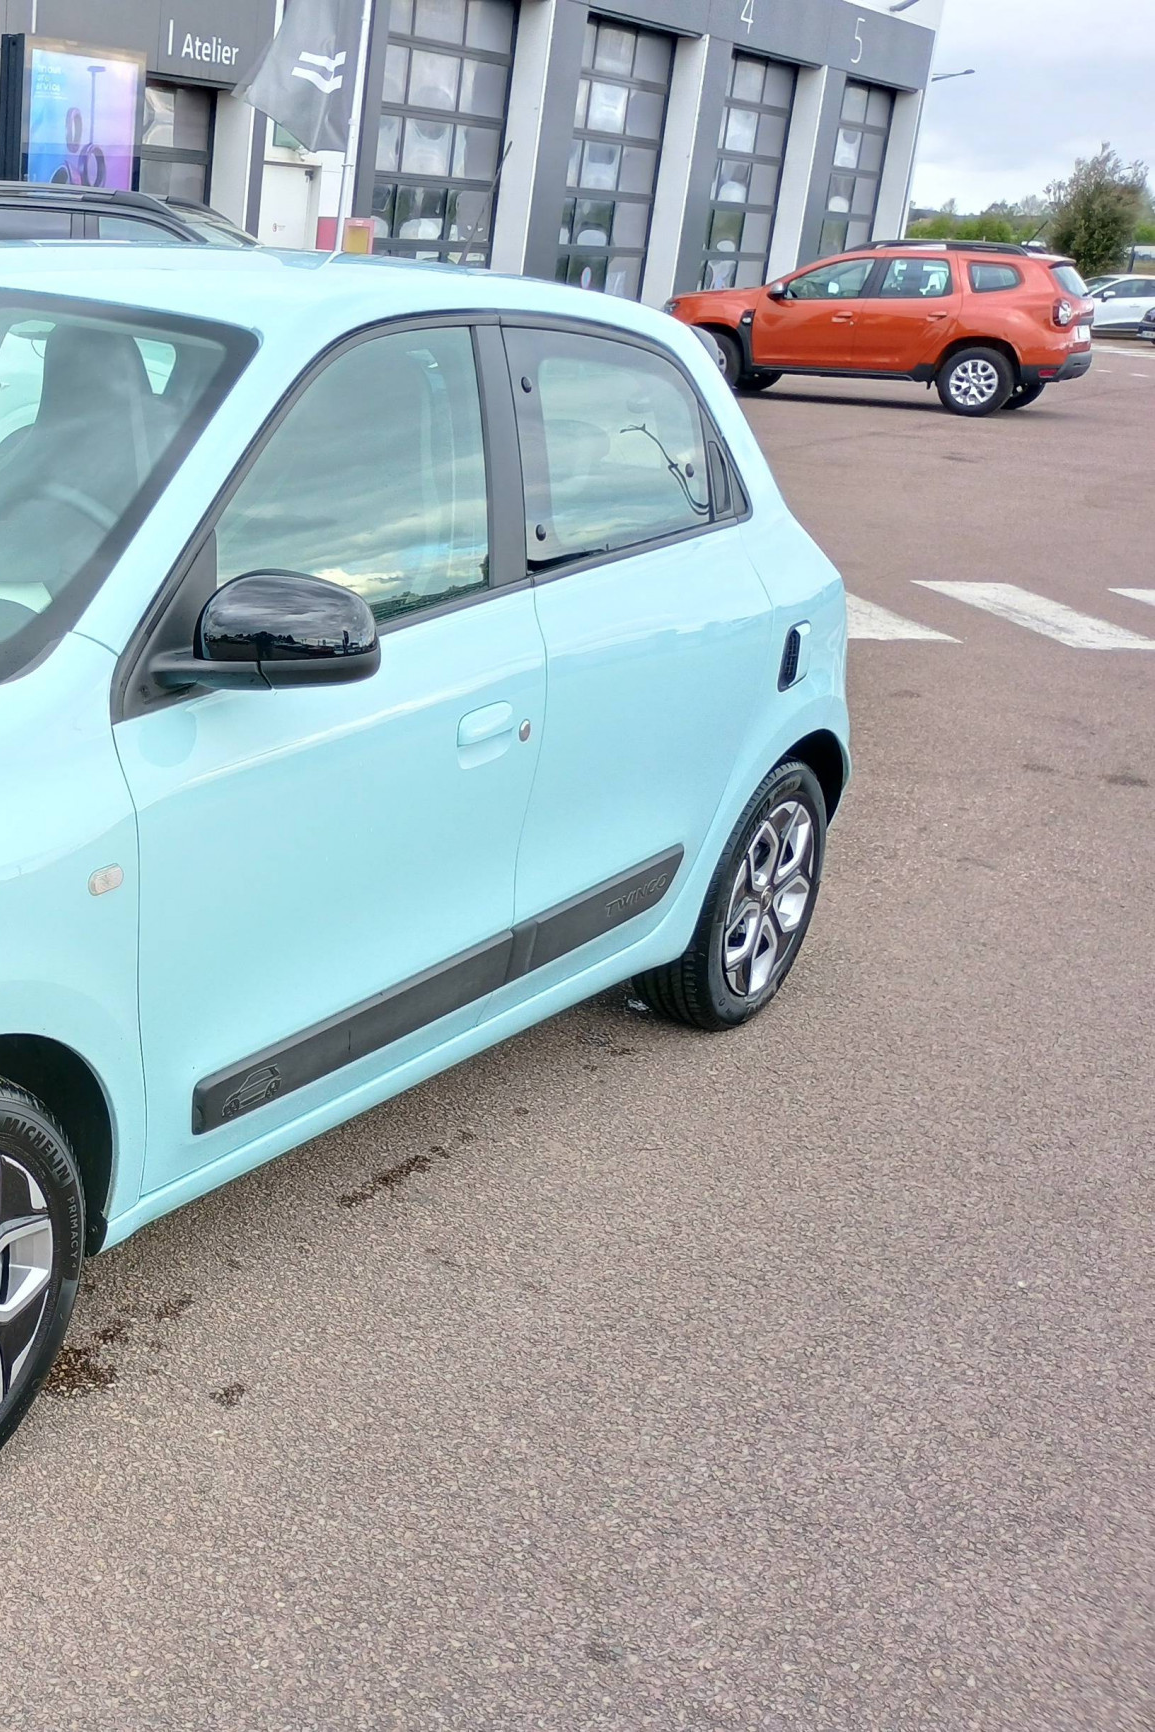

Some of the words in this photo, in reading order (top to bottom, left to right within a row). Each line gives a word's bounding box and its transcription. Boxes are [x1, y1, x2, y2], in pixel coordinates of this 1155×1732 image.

[740, 0, 754, 34] 4
[181, 32, 240, 66] Atelier
[850, 17, 865, 64] 5
[605, 872, 668, 918] TWINGO
[3, 1116, 71, 1184] MICHELIN
[66, 1196, 79, 1259] PRIMACY
